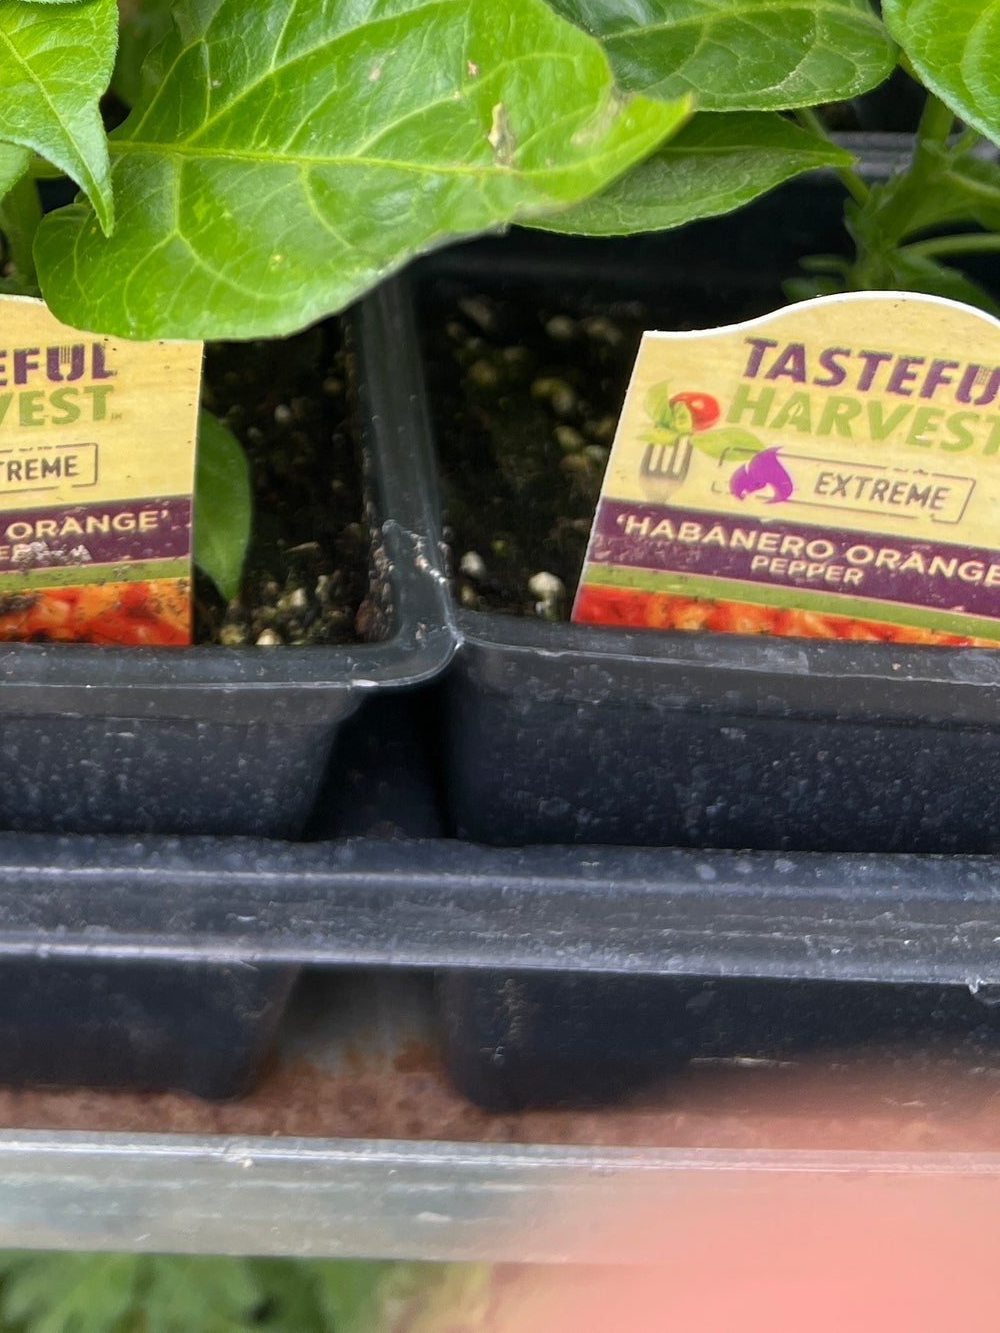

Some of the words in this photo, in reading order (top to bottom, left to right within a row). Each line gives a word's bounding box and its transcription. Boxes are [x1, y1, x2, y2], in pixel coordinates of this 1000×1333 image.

[743, 337, 1000, 406] TASTEFU
[814, 472, 951, 511] EXTREME
[750, 555, 865, 585] PEPPER
